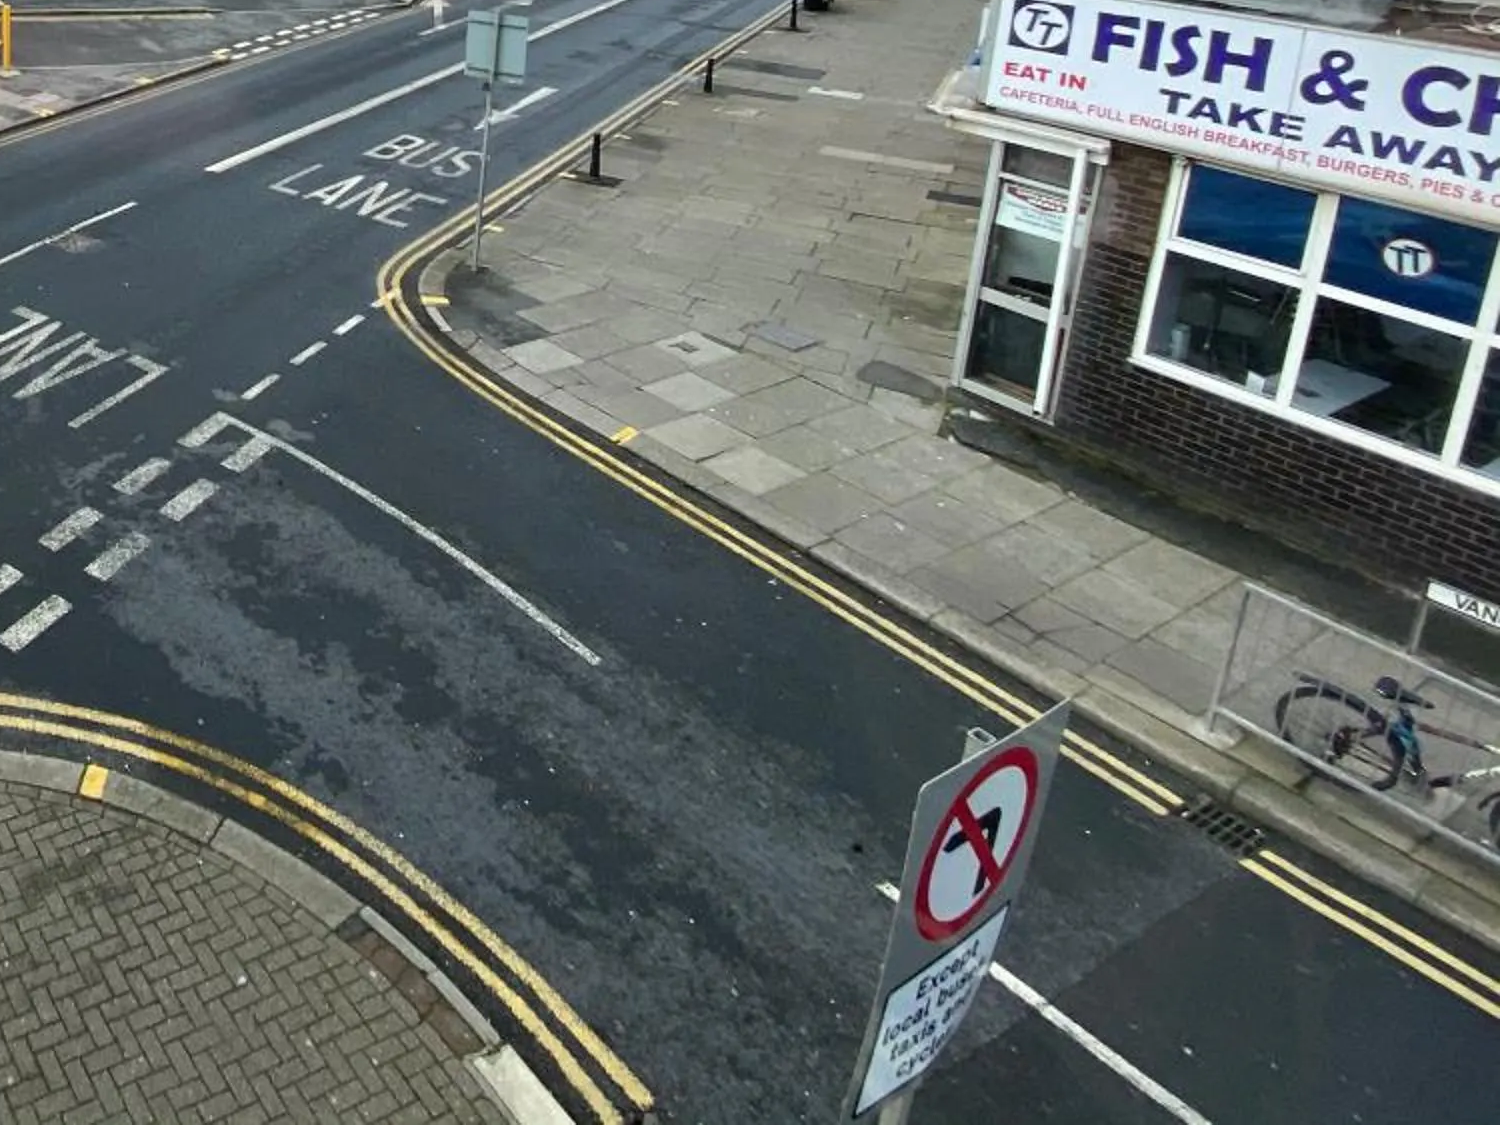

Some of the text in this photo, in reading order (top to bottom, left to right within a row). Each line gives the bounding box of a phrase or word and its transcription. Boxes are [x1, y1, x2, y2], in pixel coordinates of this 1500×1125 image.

[1004, 61, 1087, 91] EAT IN
[1091, 11, 1273, 92] FISH
[1301, 50, 1369, 111] &
[362, 134, 486, 178] BUS
[1000, 86, 1083, 115] CAFETERIA,
[1087, 104, 1125, 123] FULL
[1130, 114, 1199, 139] ENGLISH
[1204, 129, 1311, 168] BREAKFAST,
[1316, 154, 1414, 189] BURGERS,
[1421, 178, 1464, 199] PIES
[1470, 190, 1484, 203] &
[1159, 88, 1500, 182] TAKE AWAY
[268, 163, 448, 228] LANE
[916, 939, 980, 1001] Except
[882, 997, 931, 1046] local
[890, 1019, 937, 1062] taxis
